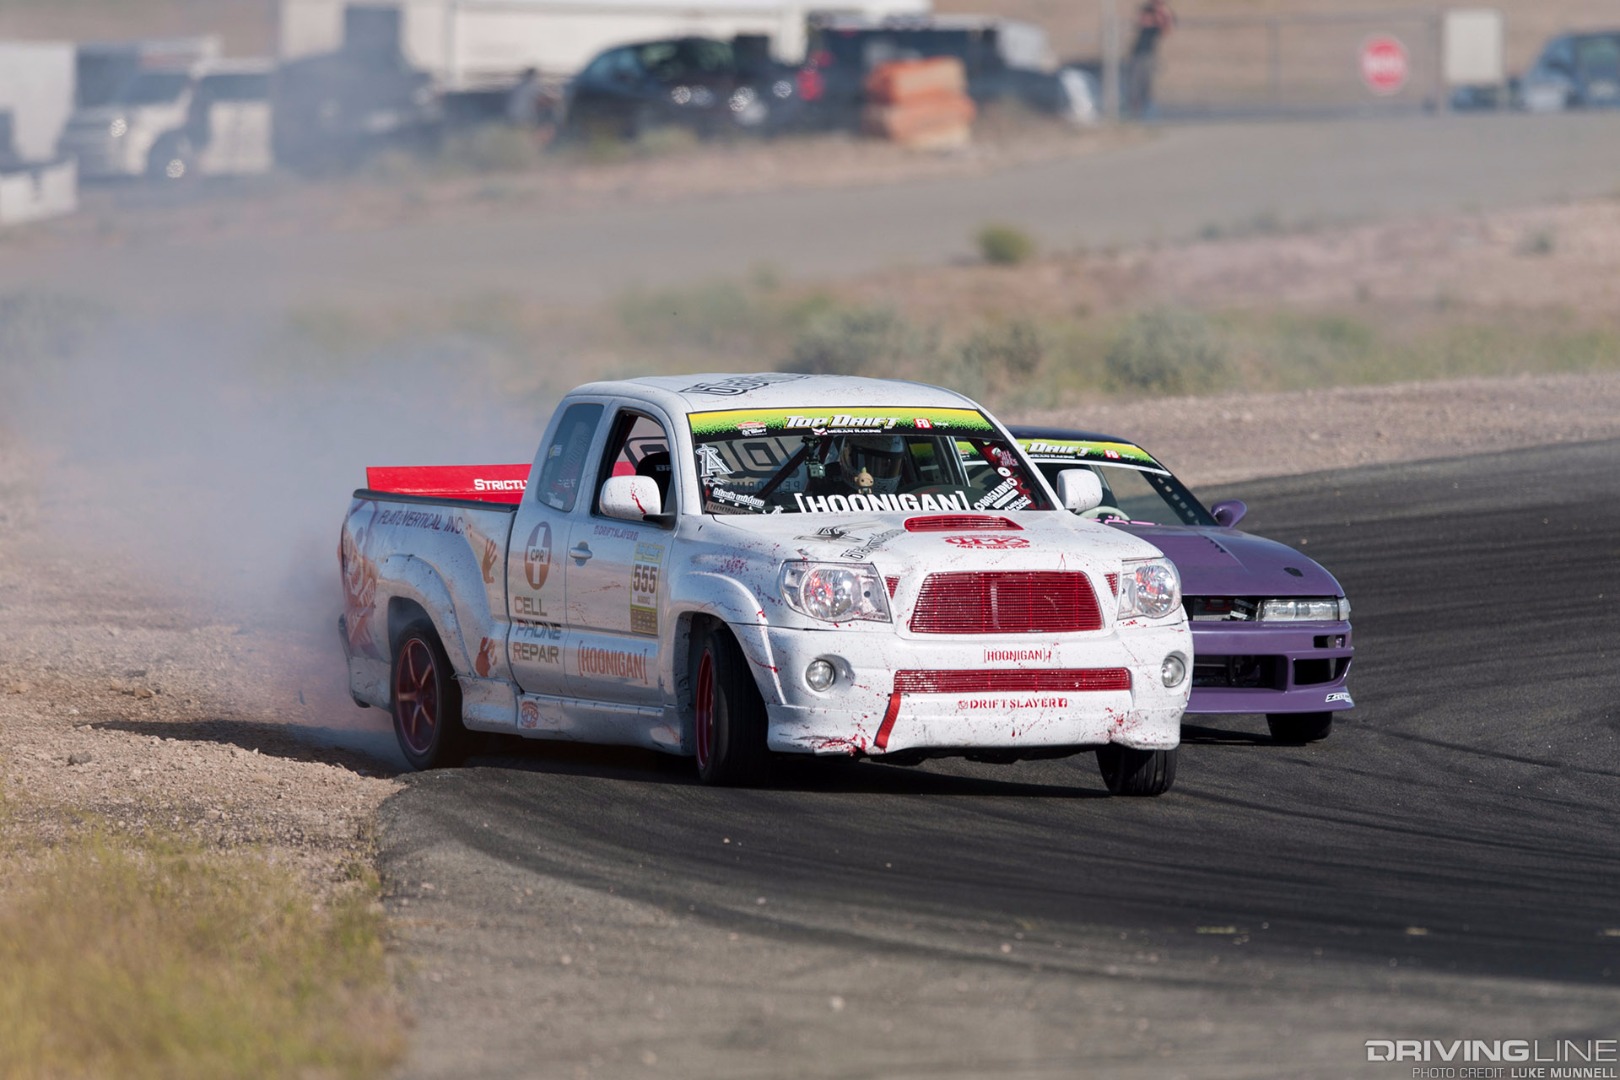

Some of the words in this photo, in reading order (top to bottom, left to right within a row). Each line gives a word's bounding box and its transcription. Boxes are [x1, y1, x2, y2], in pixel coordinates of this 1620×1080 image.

[633, 564, 657, 594] 555
[514, 596, 547, 616] CELL
[515, 619, 561, 640] PHONE
[512, 642, 559, 664] REPAIR
